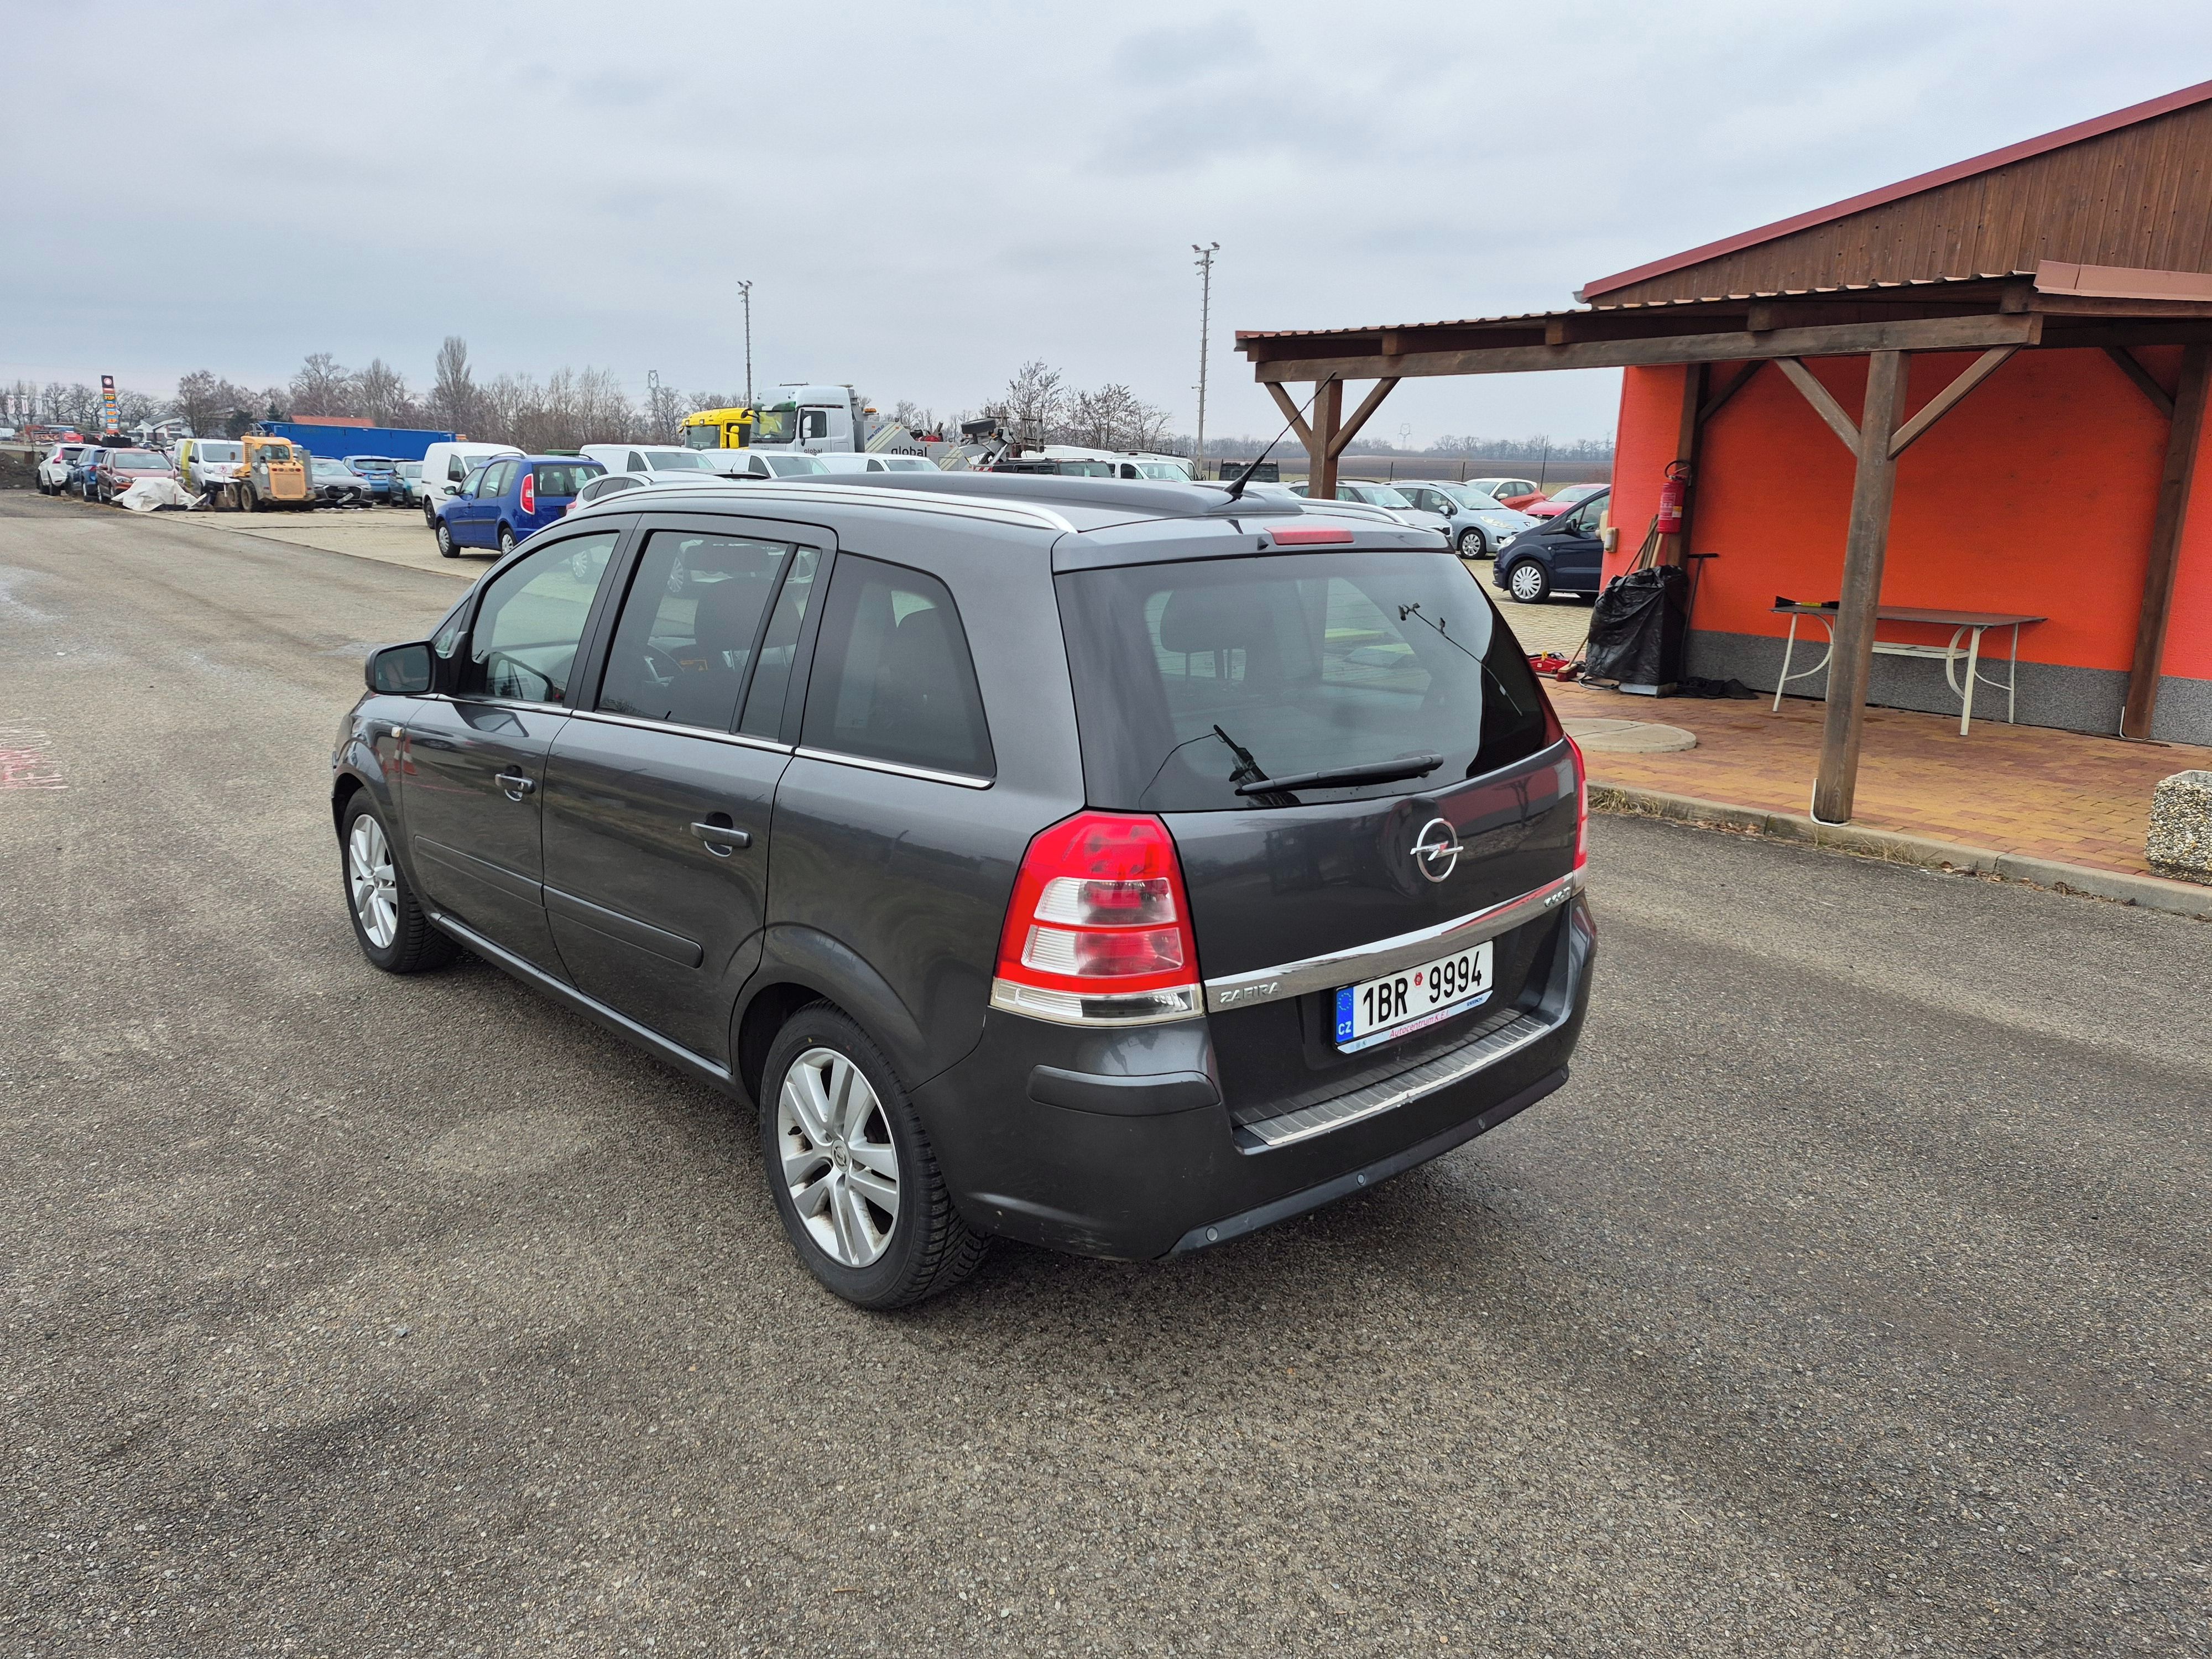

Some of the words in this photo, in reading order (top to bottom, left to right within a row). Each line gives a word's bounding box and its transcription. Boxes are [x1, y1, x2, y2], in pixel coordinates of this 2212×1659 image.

[891, 446, 927, 457] global
[1220, 982, 1278, 1003] ZAFIRA
[1363, 977, 1408, 1026] 1BR
[1429, 951, 1482, 1003] 9994
[1338, 1021, 1352, 1035] CZ
[1389, 1016, 1434, 1038] Autocentrum
